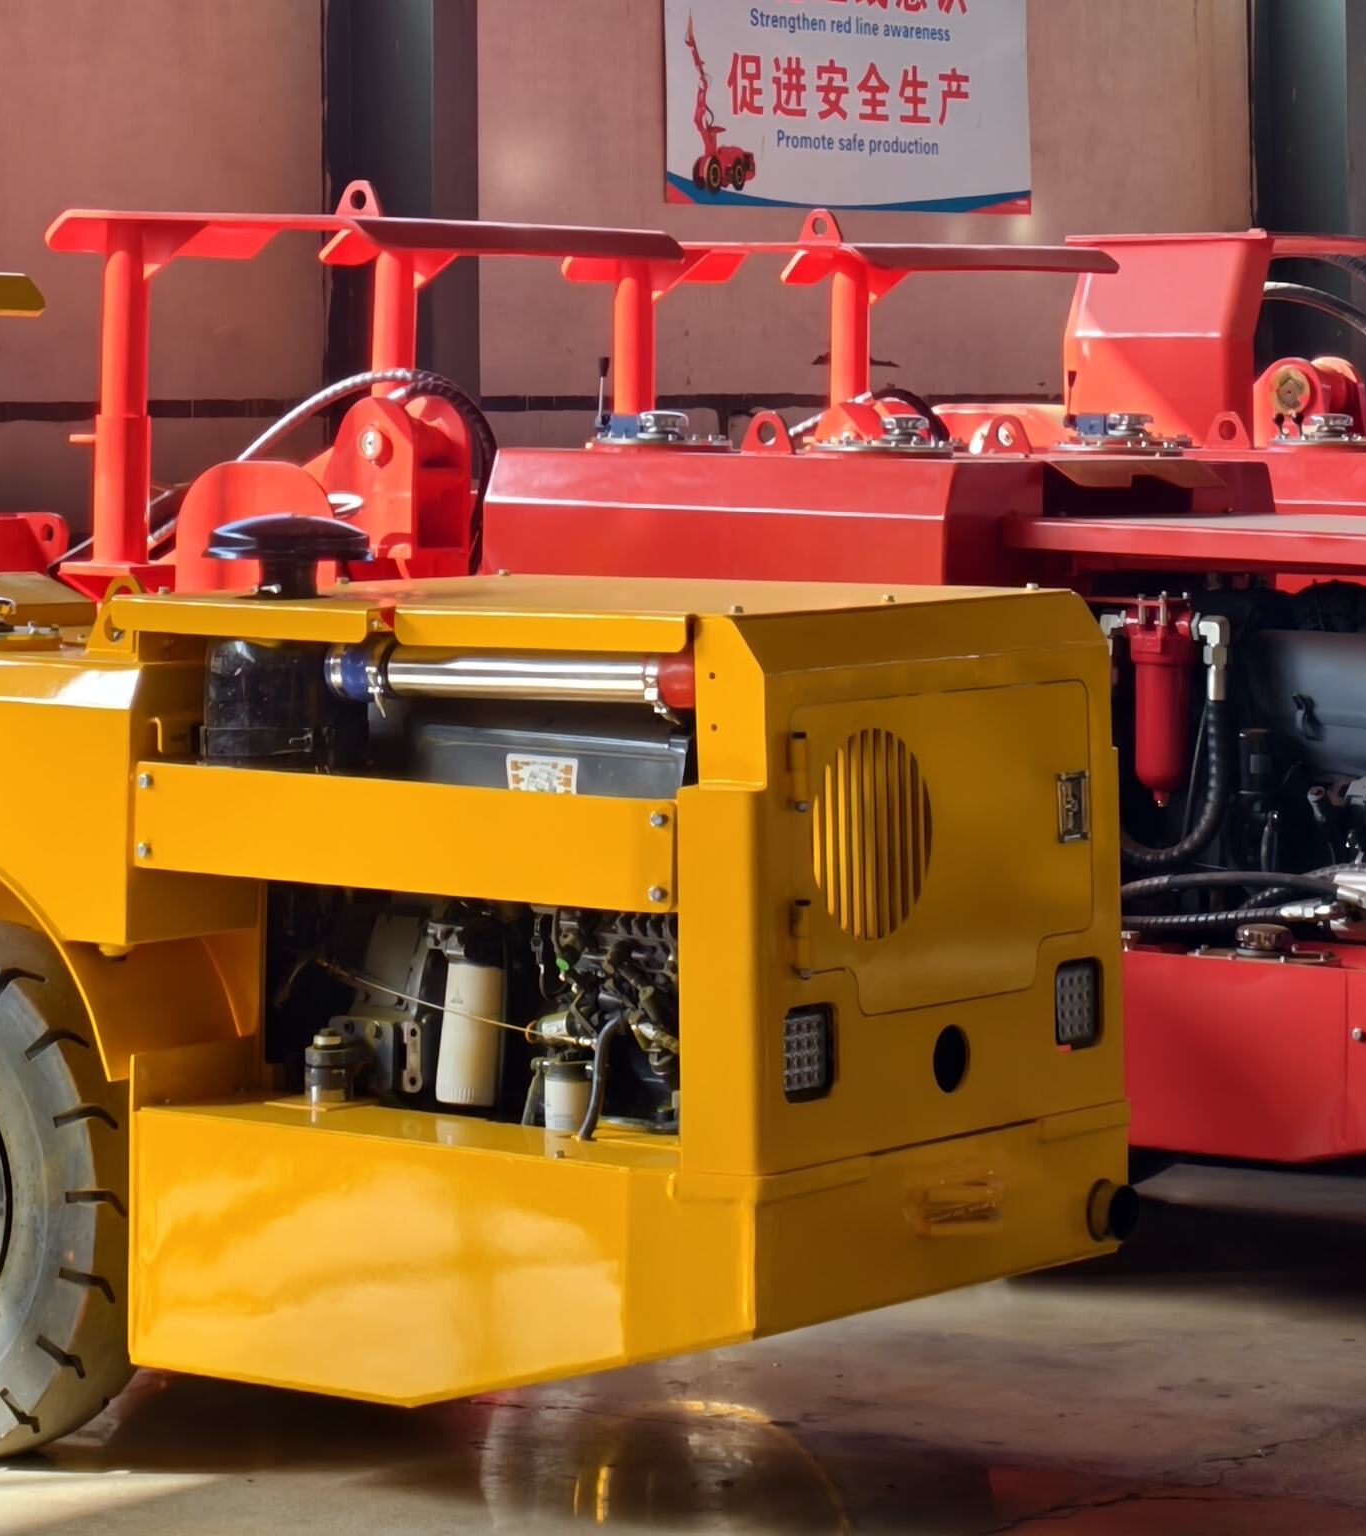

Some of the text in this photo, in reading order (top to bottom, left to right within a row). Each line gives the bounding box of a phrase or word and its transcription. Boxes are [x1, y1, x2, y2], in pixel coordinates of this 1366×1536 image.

[750, 7, 951, 42] Strengthen red line awareness
[727, 52, 970, 126] 促进安全生产
[777, 129, 939, 156] Promote safe production
